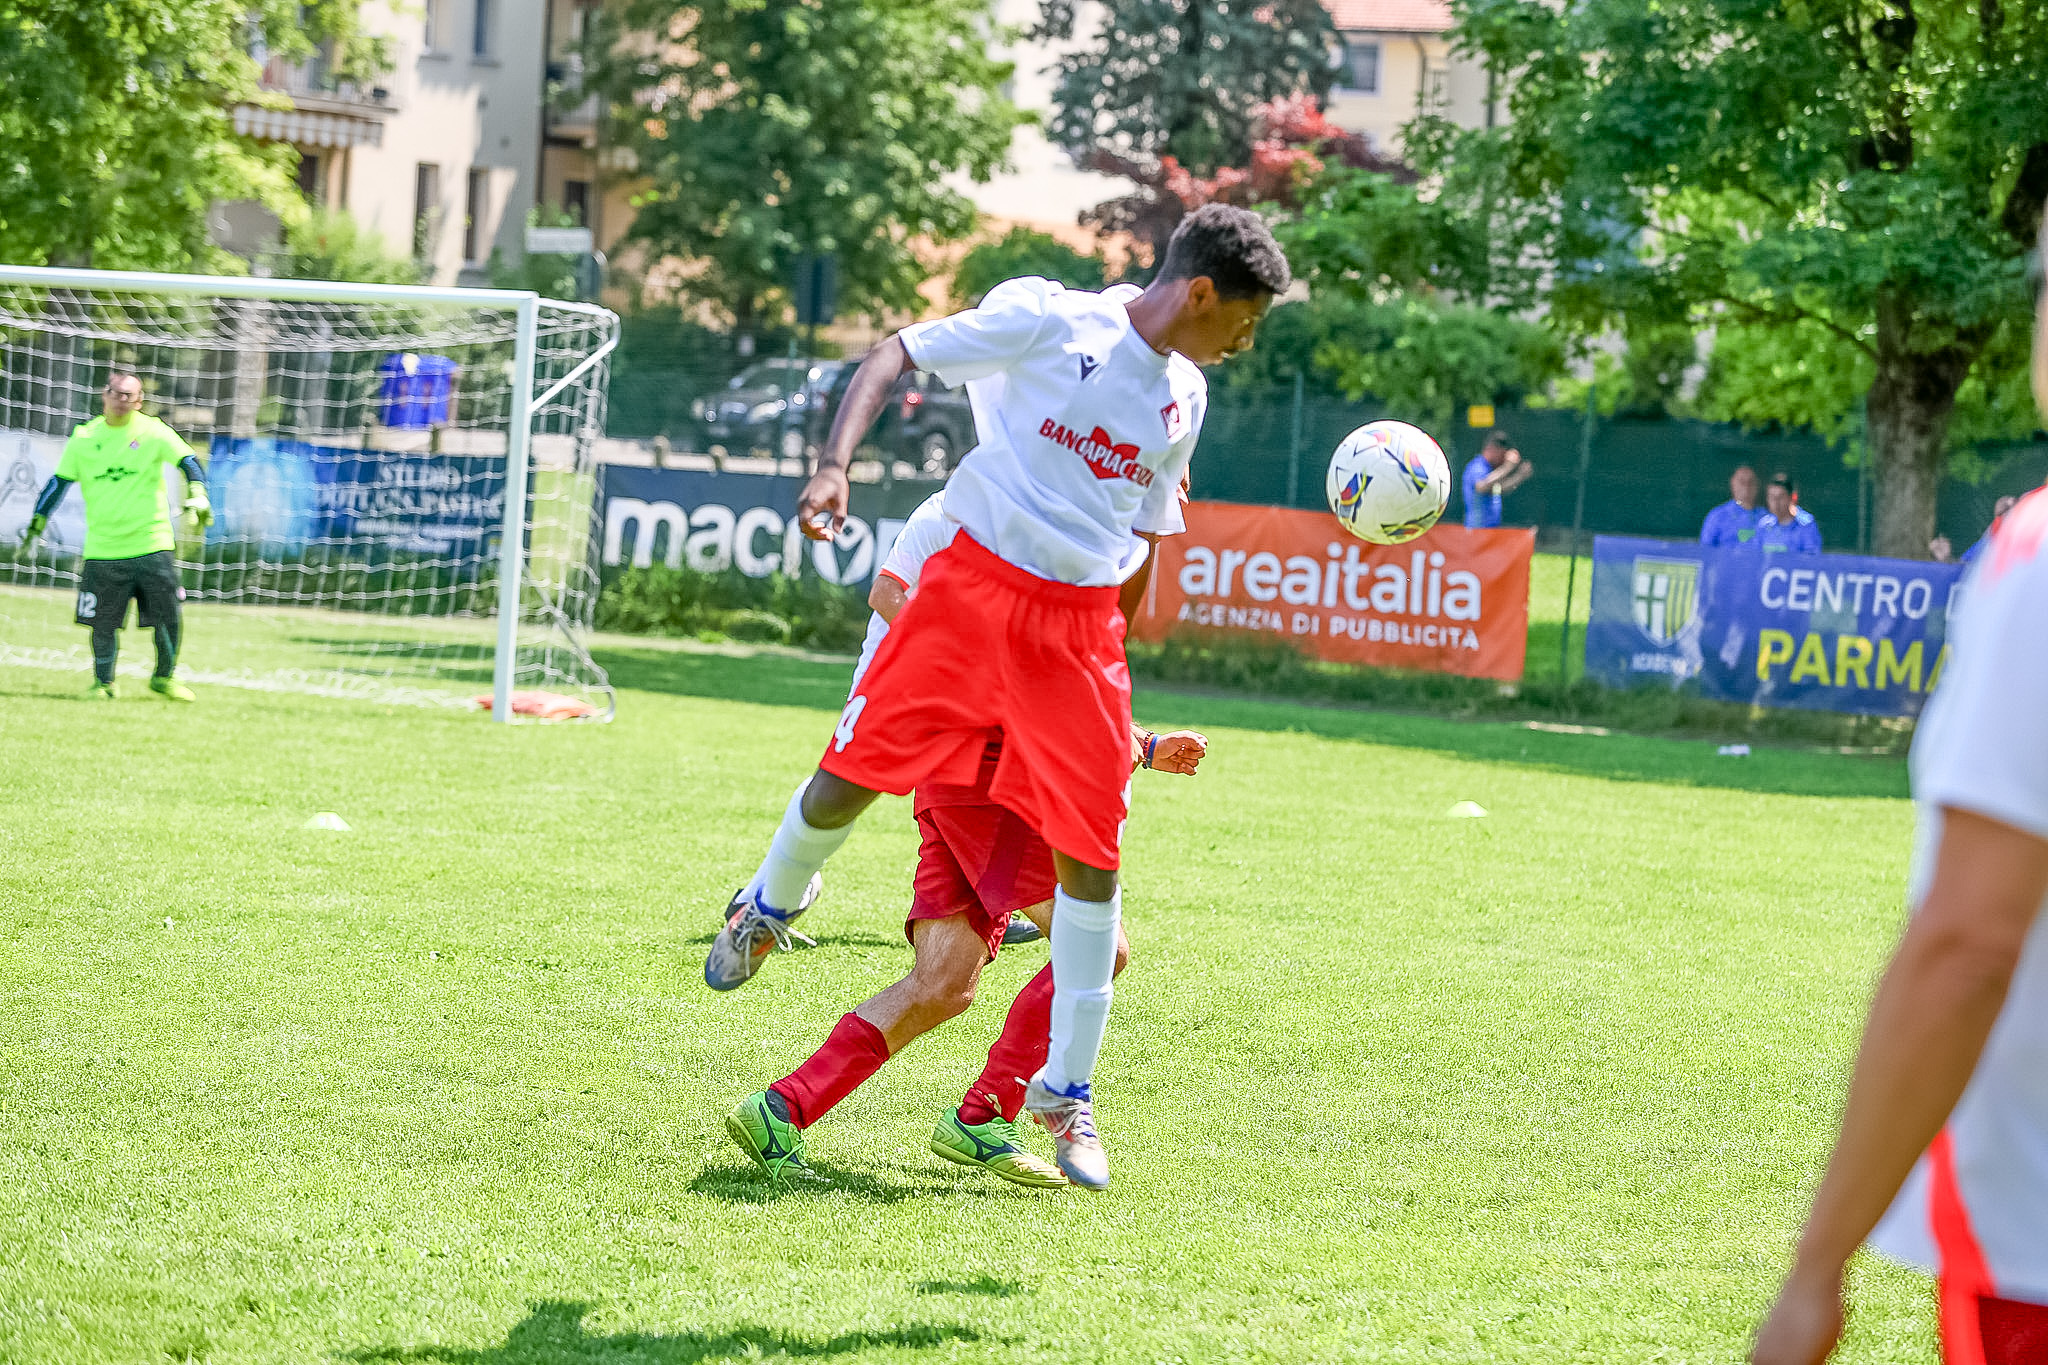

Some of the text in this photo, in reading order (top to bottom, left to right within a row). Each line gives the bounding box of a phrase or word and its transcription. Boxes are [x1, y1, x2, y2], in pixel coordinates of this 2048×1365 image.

[1178, 541, 1482, 622] areaitalia
[1759, 567, 1932, 620] CENTRO
[78, 591, 98, 618] 12
[1177, 602, 1284, 632] AGENZIA
[1291, 611, 1321, 635] DI
